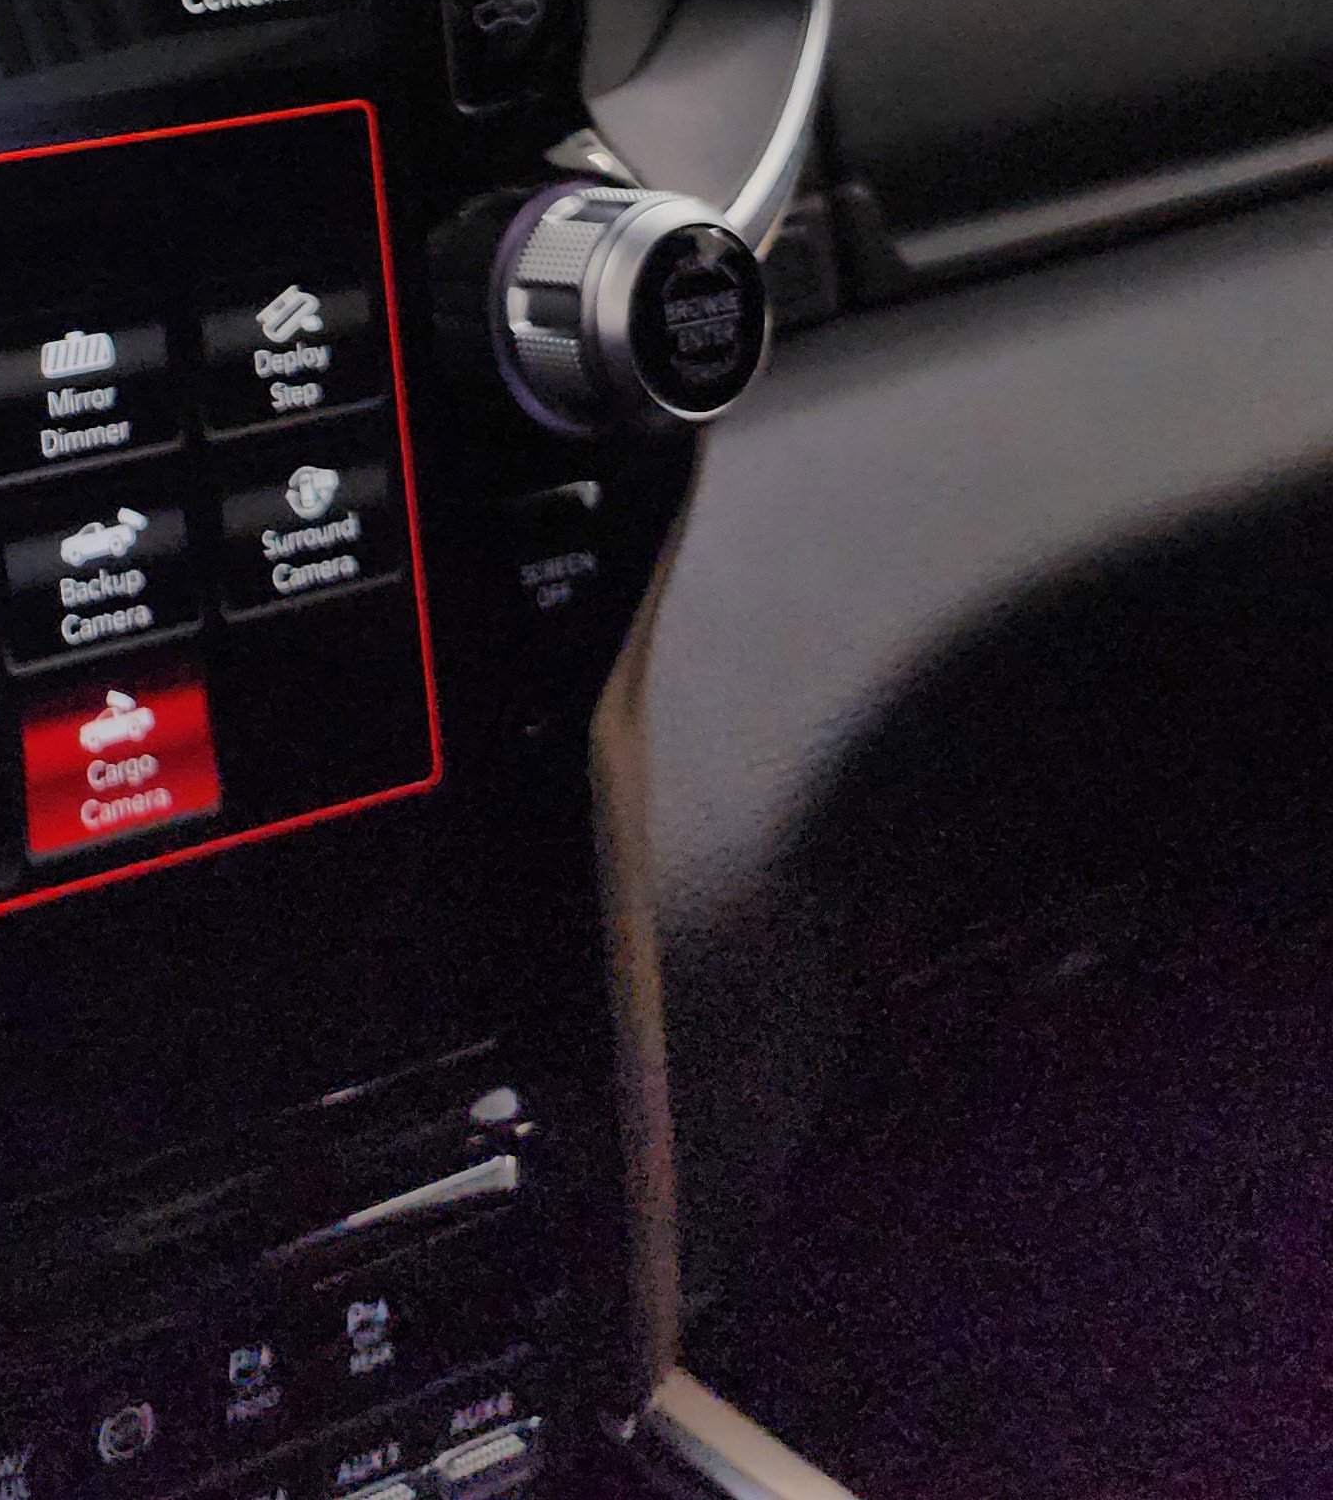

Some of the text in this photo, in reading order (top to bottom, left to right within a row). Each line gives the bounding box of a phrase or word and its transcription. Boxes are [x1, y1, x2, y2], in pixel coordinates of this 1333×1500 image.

[254, 342, 331, 379] Deploy
[47, 386, 117, 419] Mirror
[269, 382, 323, 412] Step
[41, 420, 131, 459] Dimmer
[261, 512, 361, 558] Surround
[59, 567, 148, 608] Backup
[271, 553, 358, 594] Camera
[60, 602, 155, 645] Camera
[86, 752, 159, 793] Cargo
[80, 786, 172, 832] Camera
